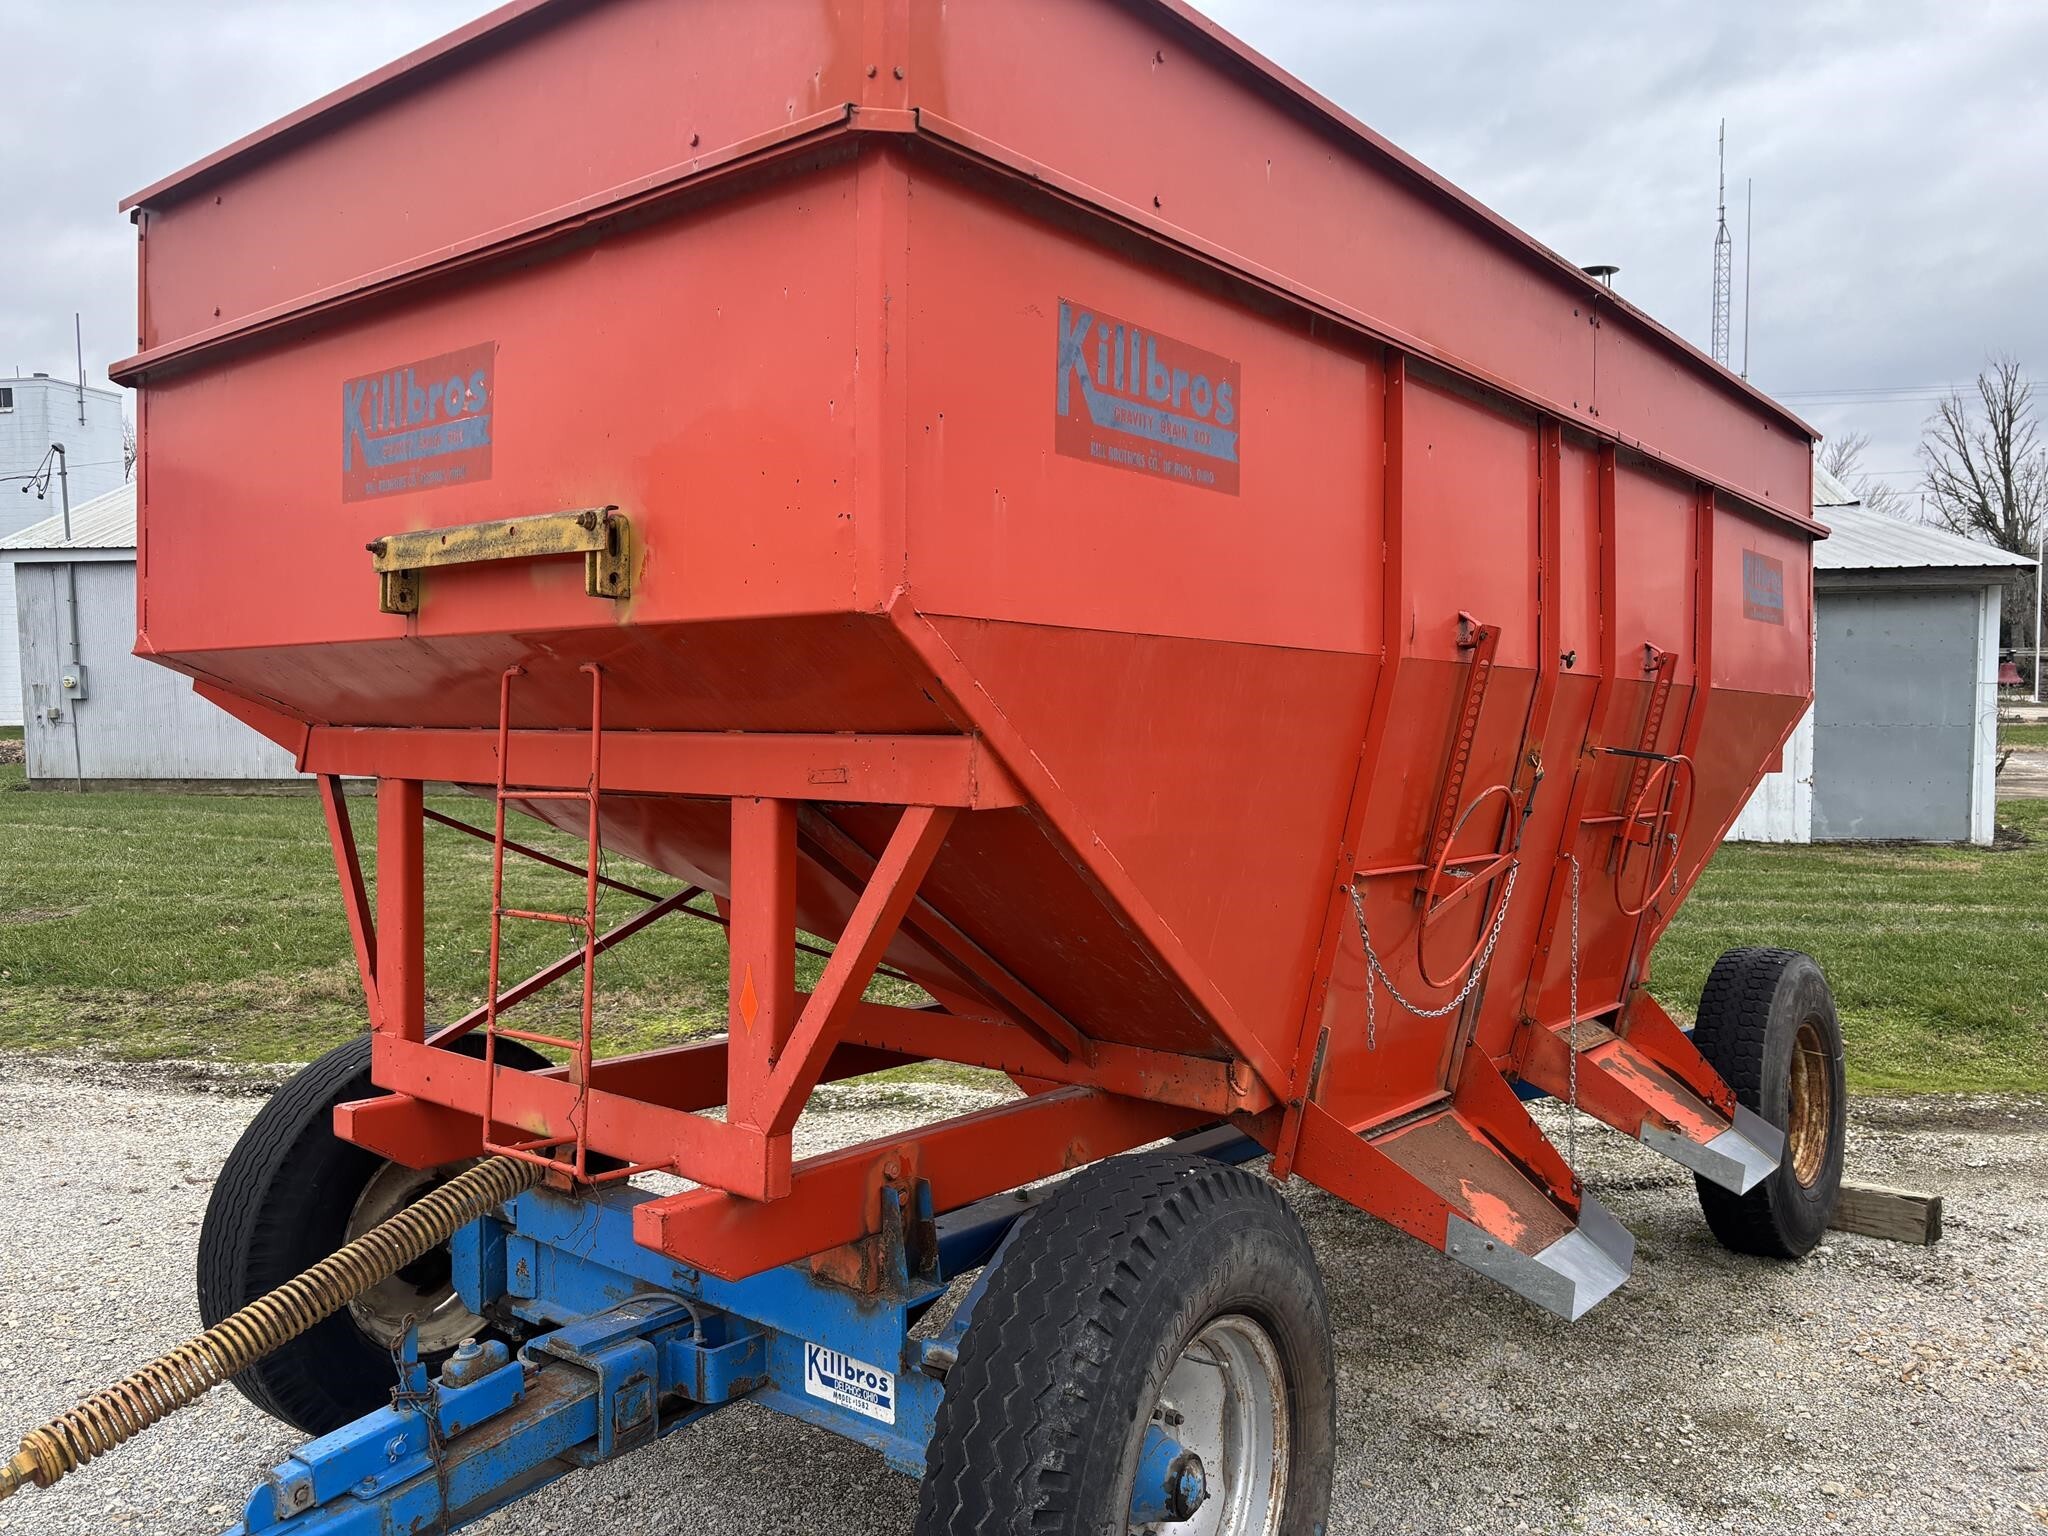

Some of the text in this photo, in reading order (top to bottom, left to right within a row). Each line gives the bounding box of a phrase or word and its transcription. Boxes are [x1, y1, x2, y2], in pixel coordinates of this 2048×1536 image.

[1057, 303, 1235, 425] Killbros
[343, 368, 488, 472] Killbros
[1113, 406, 1212, 447] GRAVITY GRAIN BOX
[808, 1344, 888, 1392] Killbros
[833, 1391, 852, 1405] MODEL
[863, 1390, 879, 1404] OHIO
